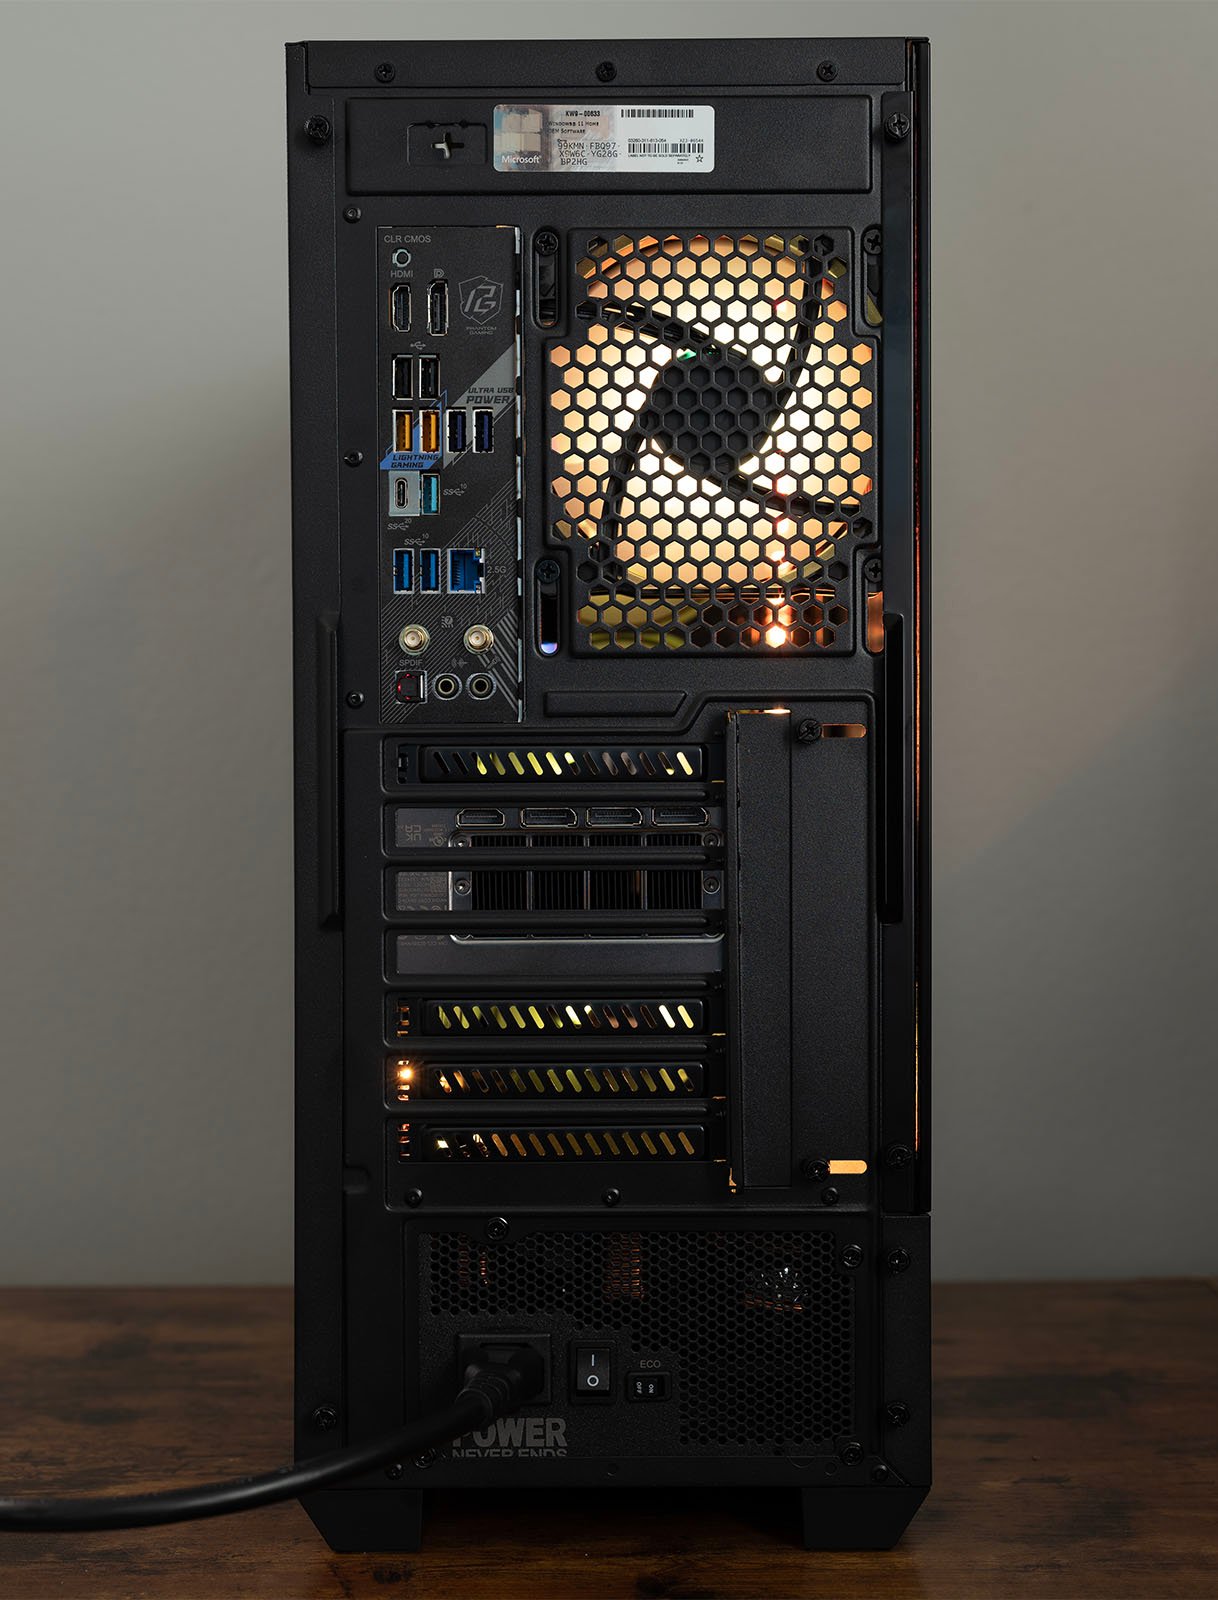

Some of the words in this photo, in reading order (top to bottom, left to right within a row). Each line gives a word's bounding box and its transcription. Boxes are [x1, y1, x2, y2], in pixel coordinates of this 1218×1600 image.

[384, 235, 402, 243] CLR
[404, 235, 432, 243] CMOS
[390, 270, 414, 278] HDMI
[466, 396, 511, 404] POWER
[487, 565, 507, 574] 2.5G
[400, 659, 423, 667] SPDIF
[640, 1360, 661, 1369] ECO
